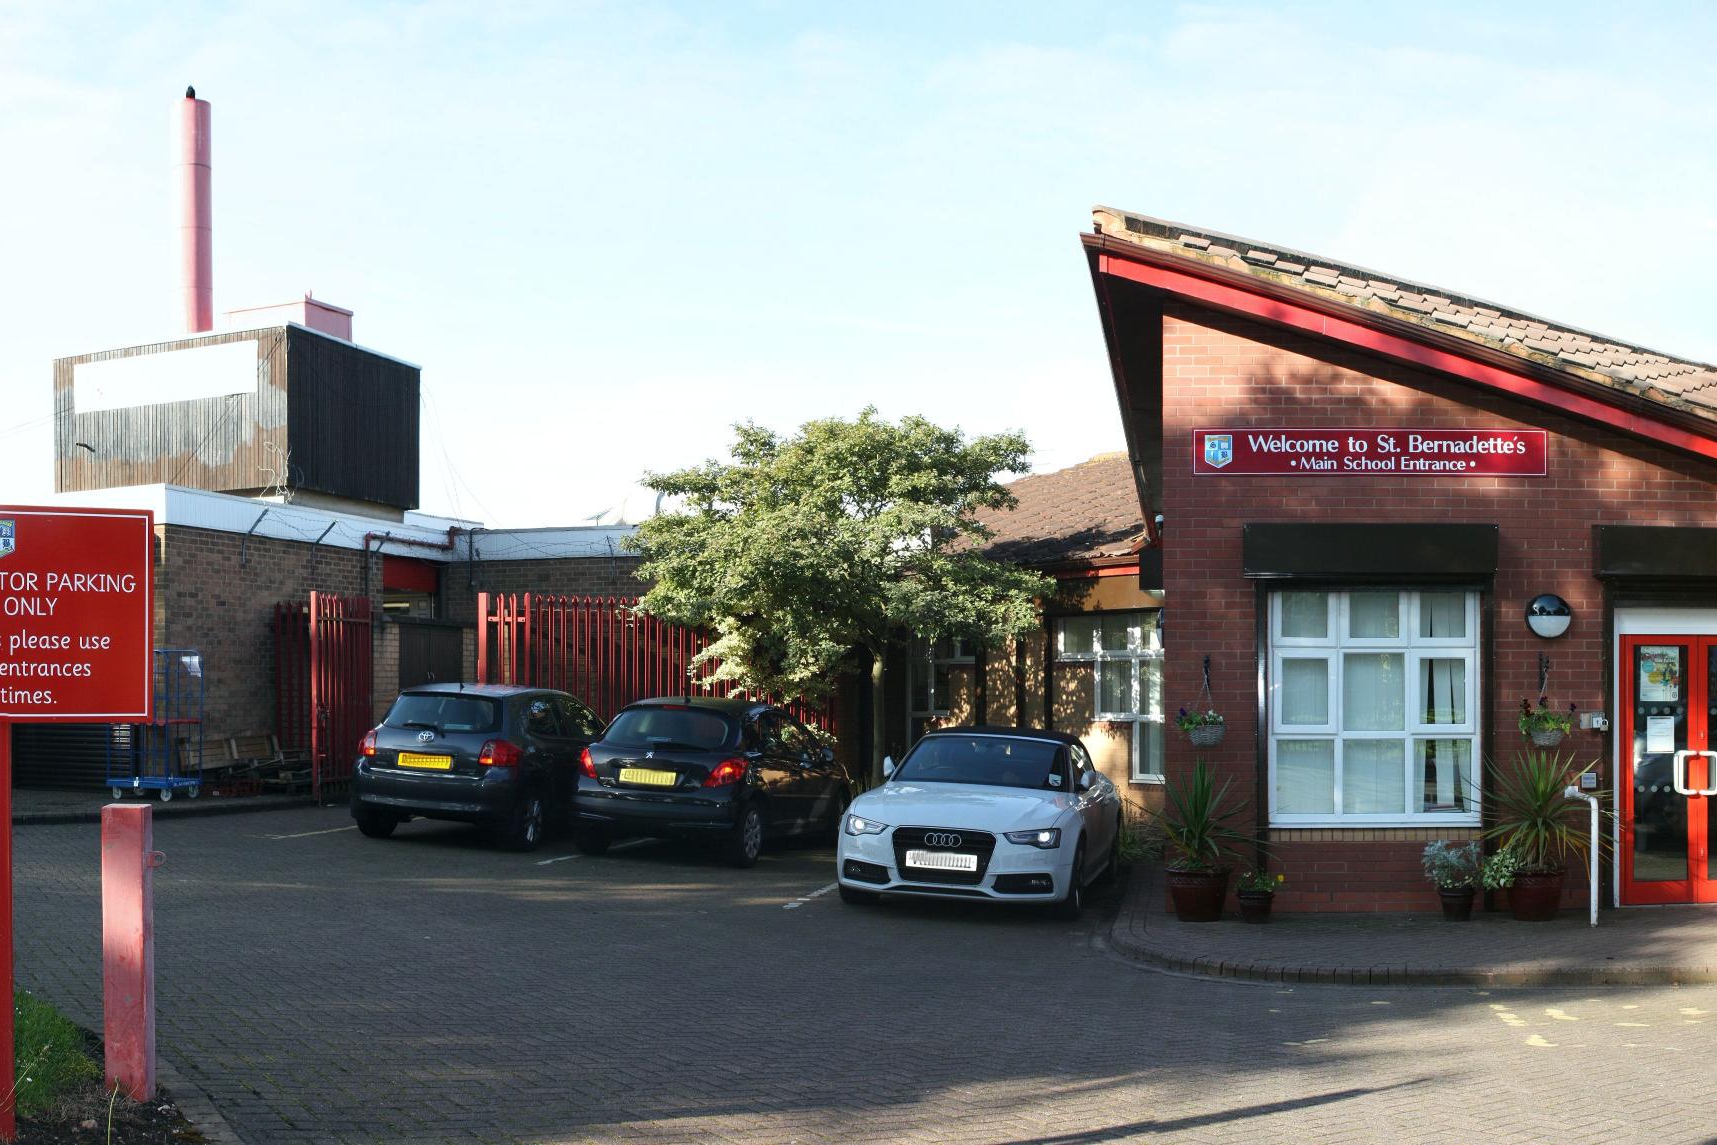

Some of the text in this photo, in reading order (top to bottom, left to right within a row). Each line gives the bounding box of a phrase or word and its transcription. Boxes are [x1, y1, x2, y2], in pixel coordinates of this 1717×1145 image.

[1247, 435, 1339, 453] Welcome
[1347, 437, 1368, 453] to
[1376, 435, 1401, 454] St.
[1408, 435, 1526, 455] Bernadette's
[1299, 456, 1467, 471] Main School Entrance
[46, 573, 137, 593] PARKING
[4, 597, 58, 616] ONLY
[9, 629, 71, 656] please
[79, 636, 111, 650] use
[0, 687, 57, 704] times.
